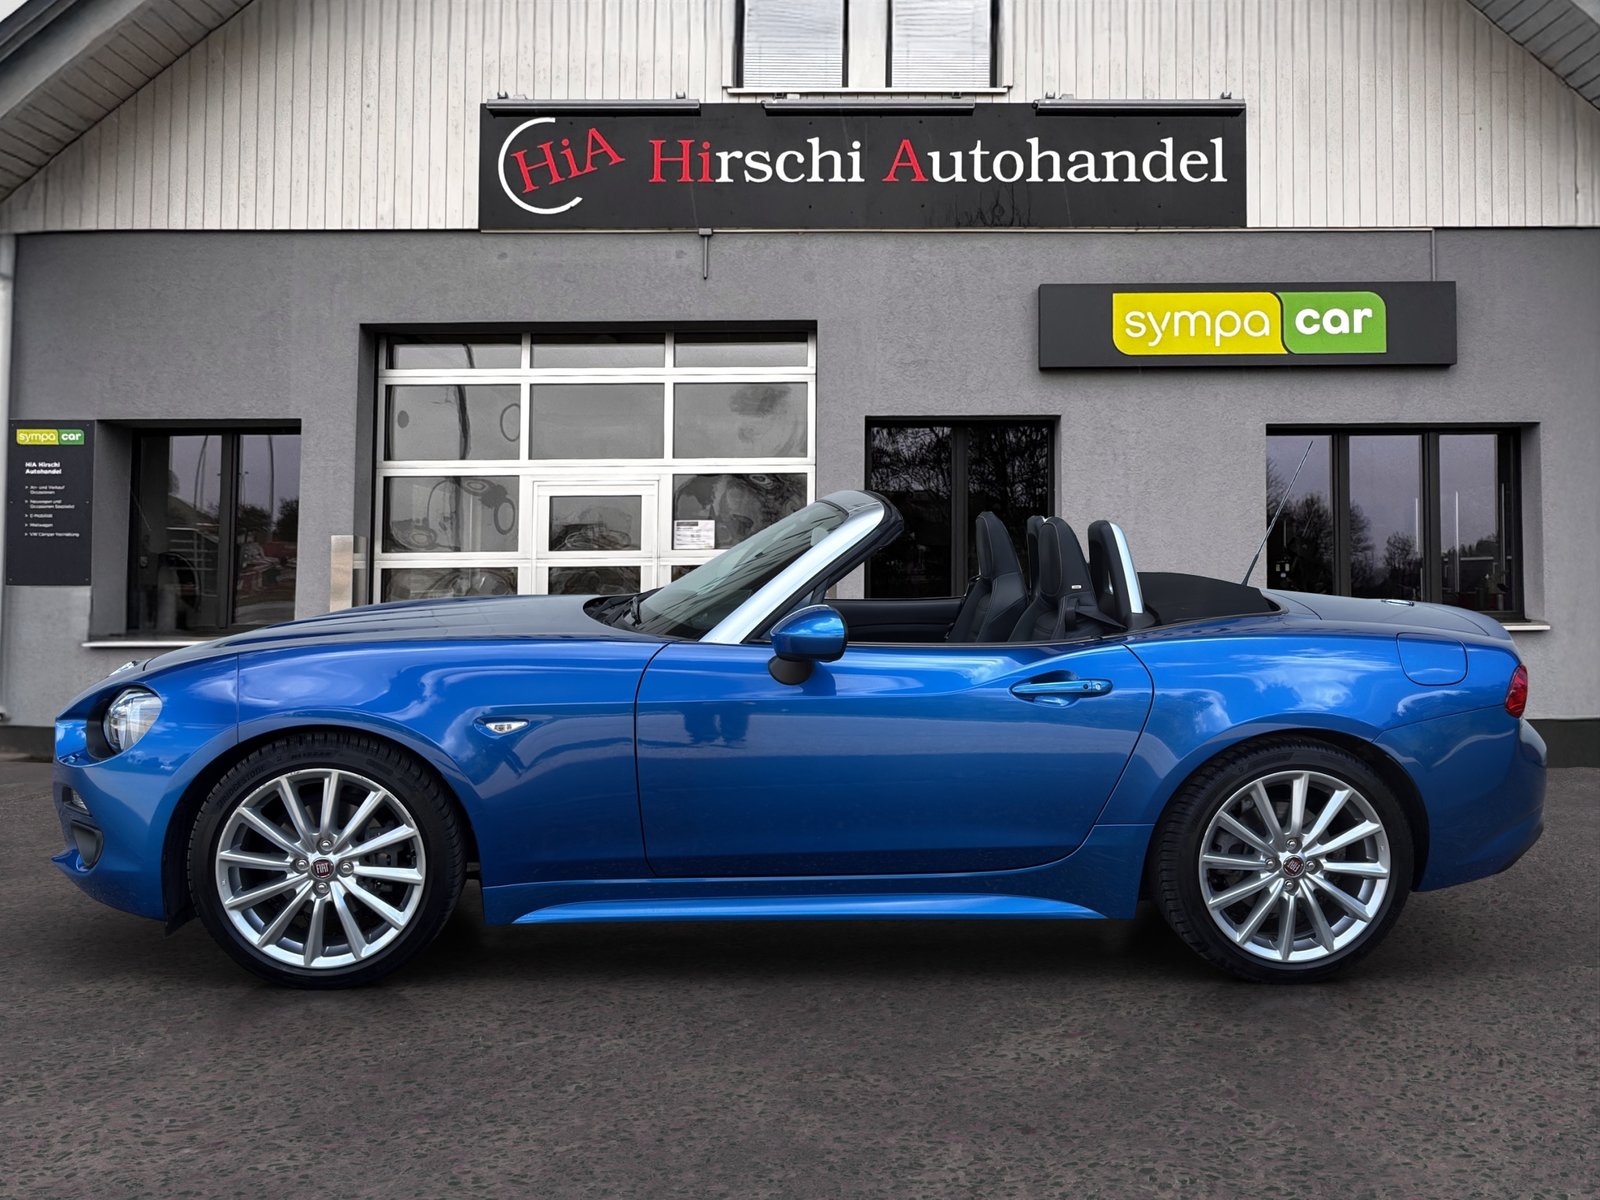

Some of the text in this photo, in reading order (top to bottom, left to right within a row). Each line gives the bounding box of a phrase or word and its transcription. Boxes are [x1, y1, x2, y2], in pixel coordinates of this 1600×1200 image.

[511, 127, 625, 193] HiA
[648, 137, 1228, 183] Hirschi Autohandel
[1124, 307, 1373, 347] sympa car
[19, 433, 82, 442] sympa car
[315, 862, 329, 874] FIAT
